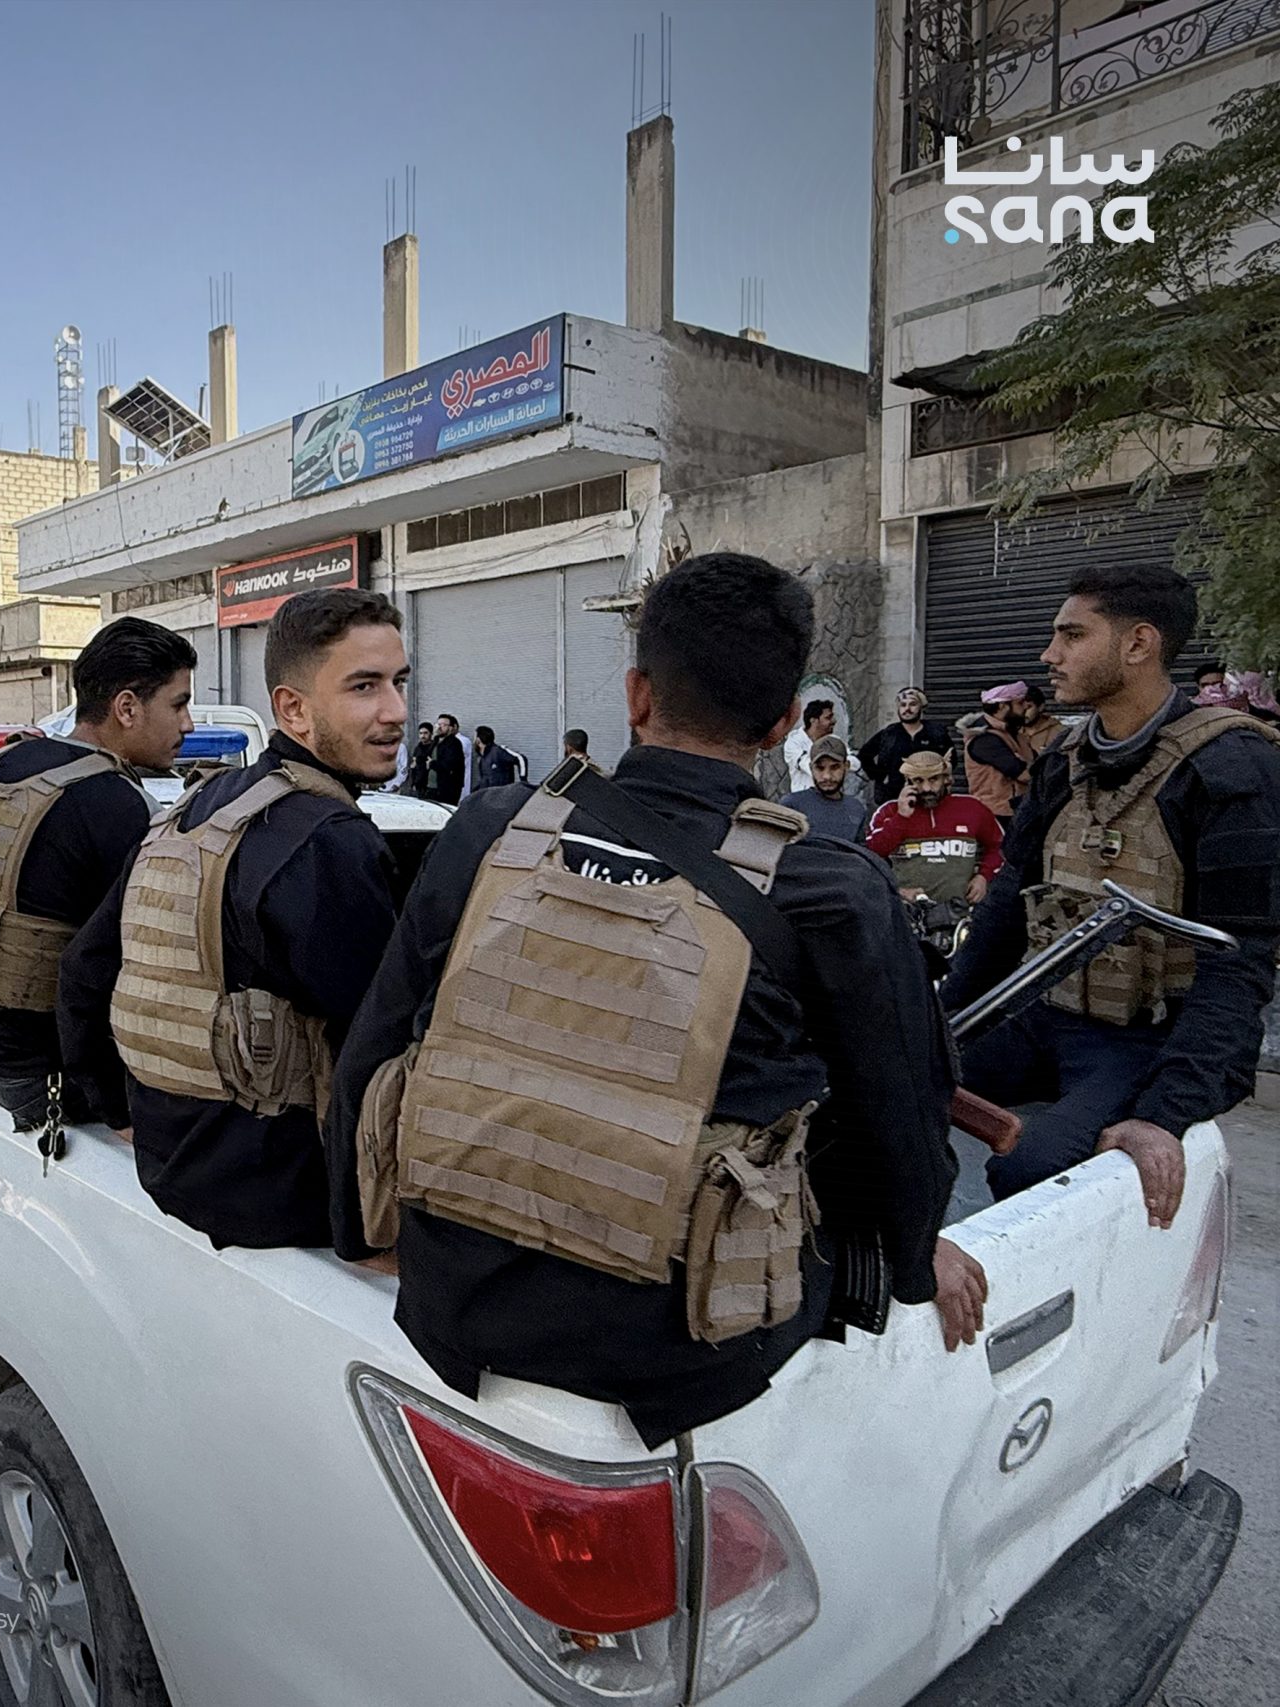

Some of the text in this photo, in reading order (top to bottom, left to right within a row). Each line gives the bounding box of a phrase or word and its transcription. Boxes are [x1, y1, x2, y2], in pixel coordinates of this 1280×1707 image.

[408, 378, 429, 396] فحص
[441, 326, 550, 419] المصري
[444, 398, 547, 444] لصيانة السيارات الحديثة
[293, 558, 351, 583] هنكوك
